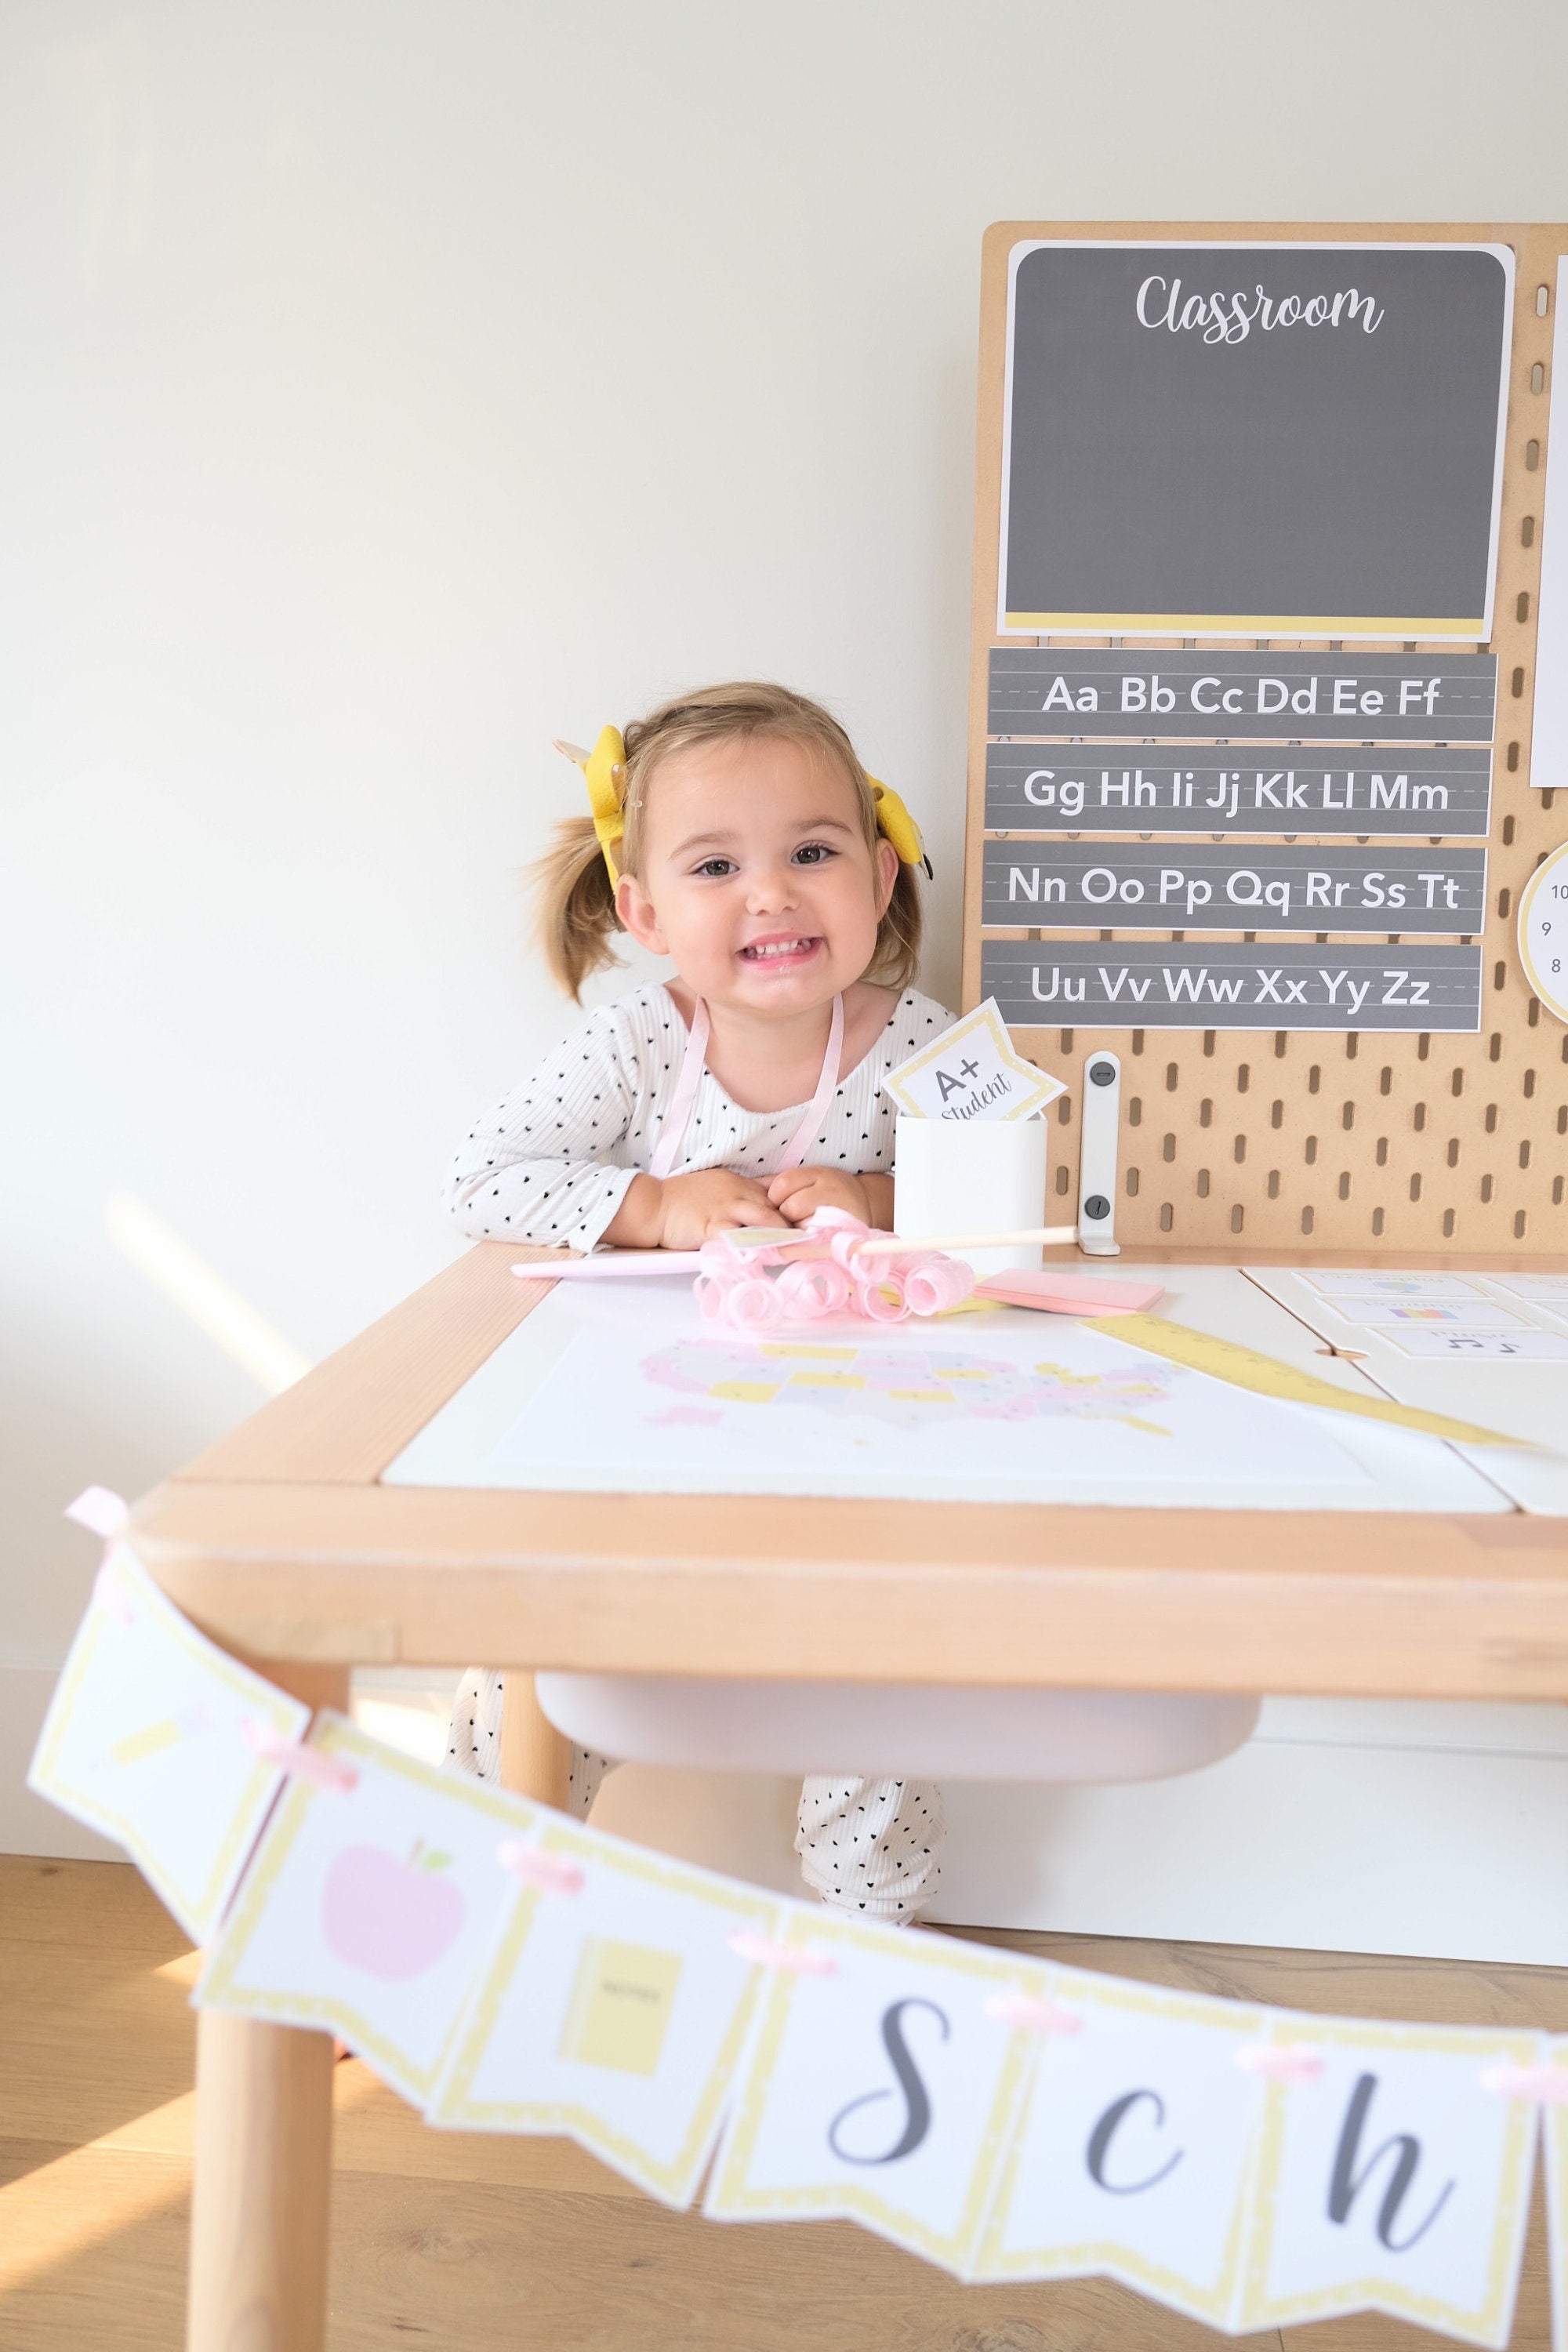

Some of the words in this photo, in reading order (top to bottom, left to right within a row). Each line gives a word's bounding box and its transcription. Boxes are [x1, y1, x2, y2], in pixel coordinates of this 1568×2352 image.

[1136, 275, 1385, 344] Classroom
[1041, 676, 1098, 712] Aa
[1121, 675, 1176, 713] Bb
[1190, 677, 1243, 714] Cc
[1257, 677, 1318, 715] Dd
[1333, 679, 1384, 716] Ee
[1399, 677, 1441, 716] Ff
[1024, 770, 1085, 816] Gg
[1101, 770, 1156, 807] Hh
[1172, 771, 1194, 807] Ii
[1205, 772, 1240, 818] Jj
[1254, 771, 1309, 808] Kk
[1323, 772, 1355, 809] Ll
[1370, 775, 1449, 810] Mm
[1009, 867, 1066, 902] Nn
[1081, 868, 1145, 904] Oo
[1160, 869, 1212, 915] Pp
[1226, 870, 1290, 916] Qq
[1306, 872, 1350, 907] Rr
[1360, 872, 1406, 909] Ss
[1417, 873, 1460, 909] Tt
[1541, 922, 1552, 936] 9
[1552, 959, 1561, 973] 8
[1032, 967, 1086, 1002] Uu
[1098, 967, 1152, 1002] Vv
[1162, 968, 1244, 1003] Ww
[1254, 969, 1308, 1004] Xx
[1318, 970, 1371, 1014] Yy
[1381, 971, 1430, 1005] Zz
[935, 1058, 979, 1102] A+
